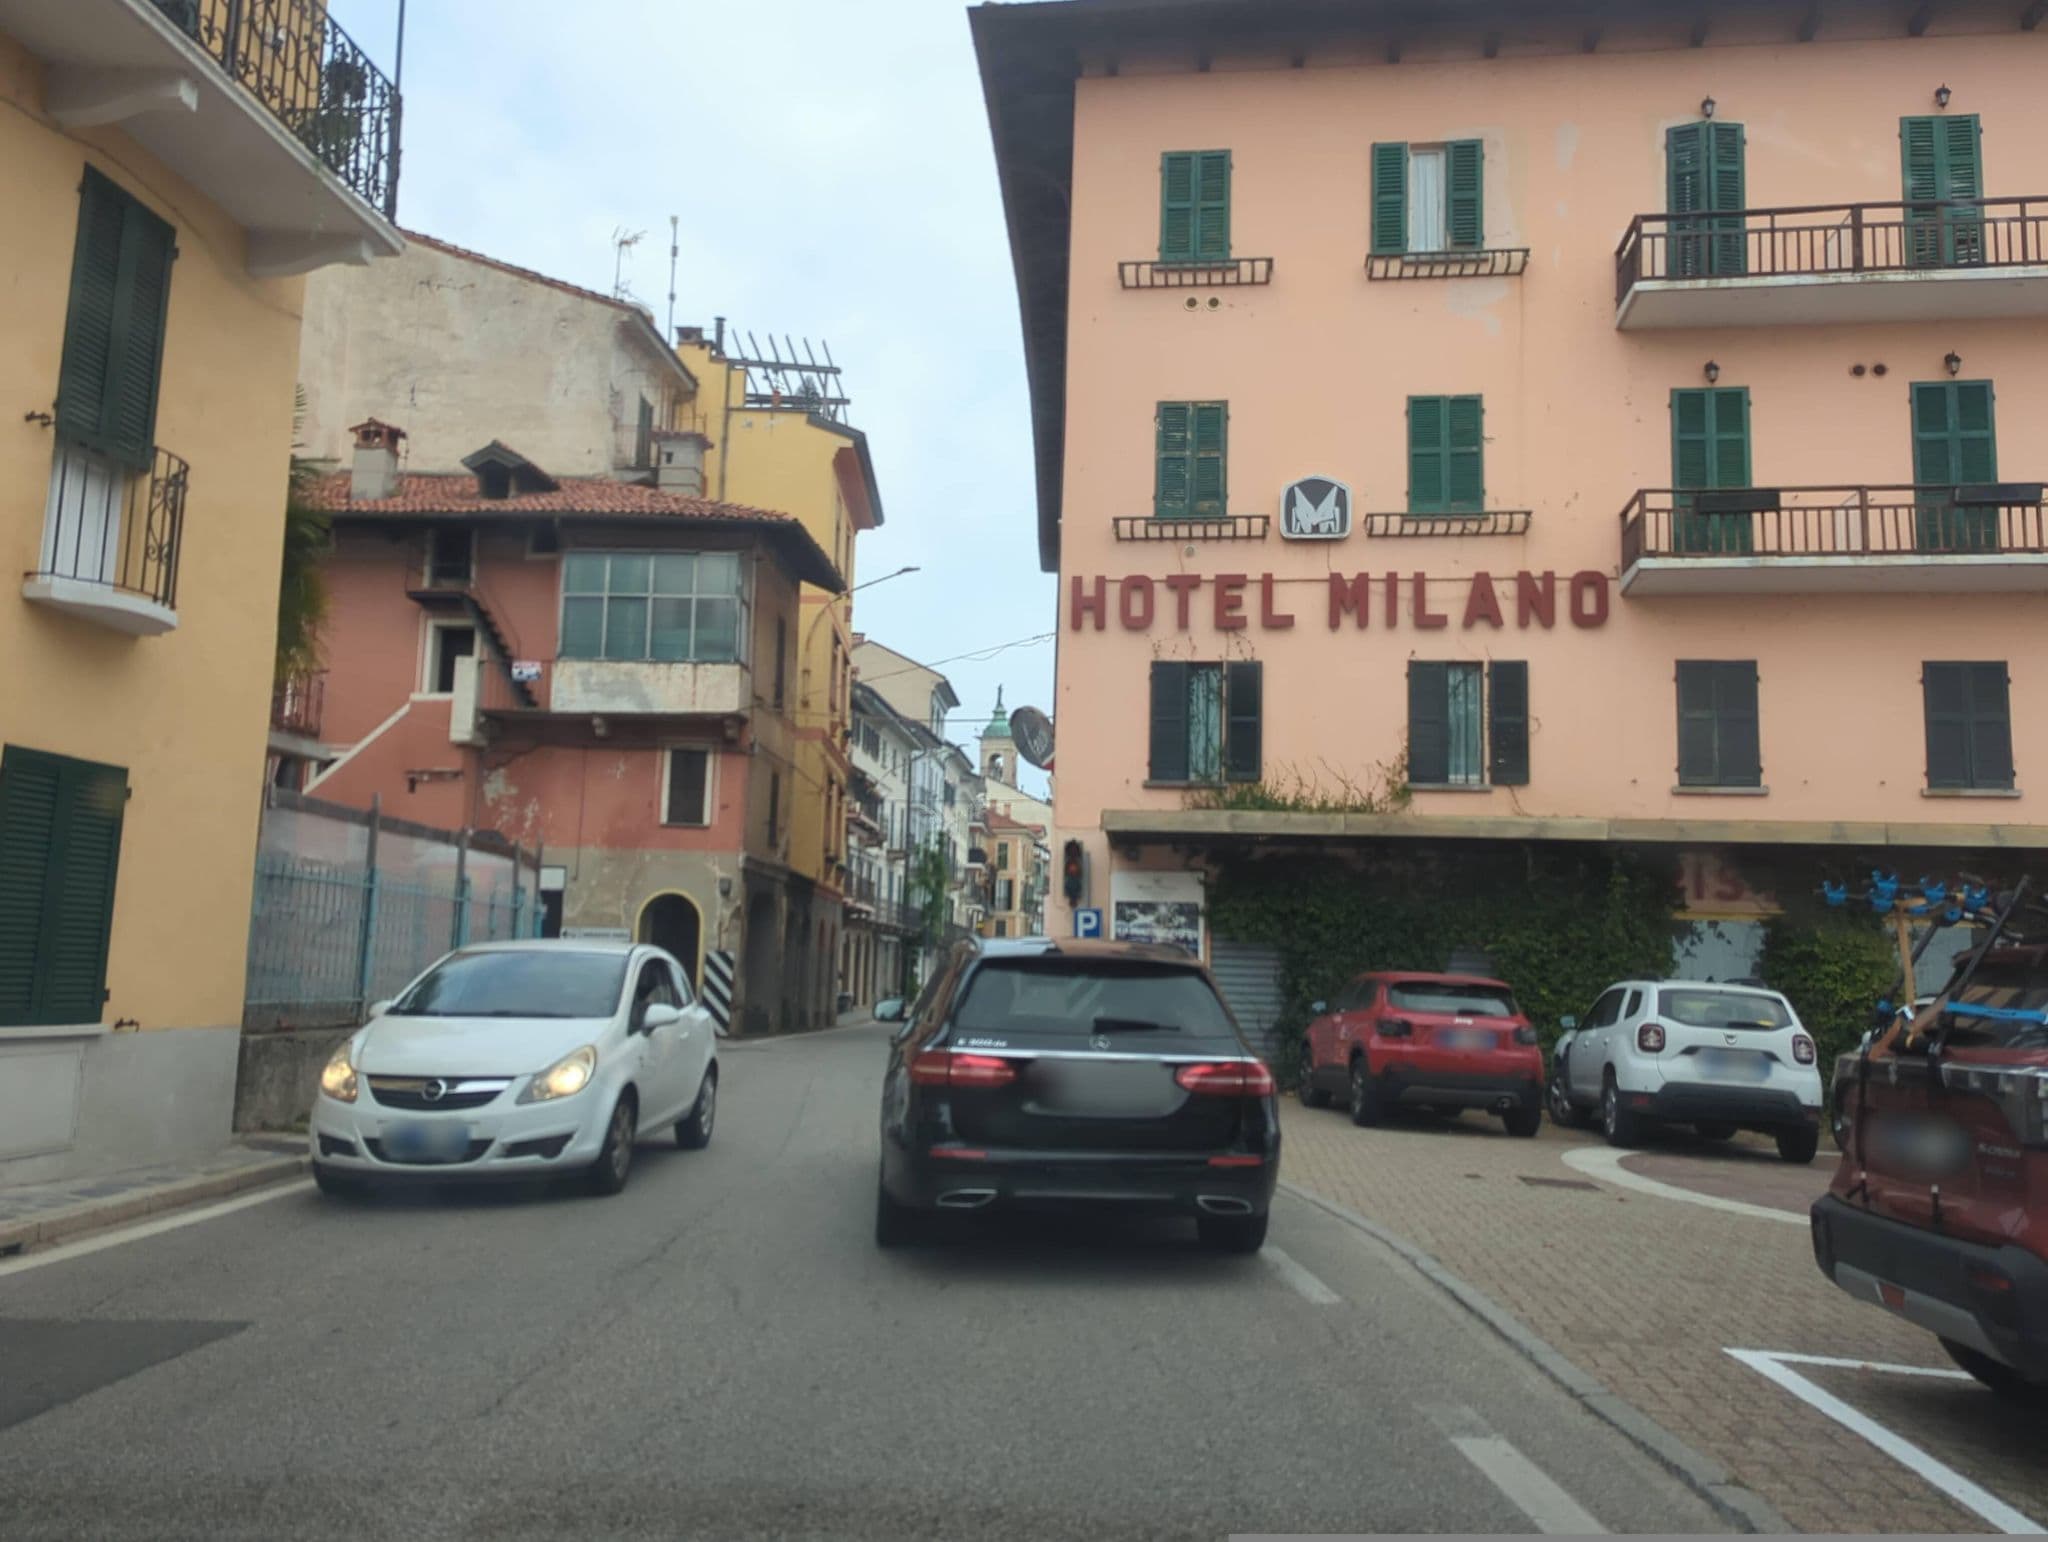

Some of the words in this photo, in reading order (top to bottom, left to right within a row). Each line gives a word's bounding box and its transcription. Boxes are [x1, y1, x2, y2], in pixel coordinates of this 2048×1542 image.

[1071, 573, 1295, 631] HOTEL
[1328, 570, 1609, 630] MILANO
[1077, 911, 1098, 937] P
